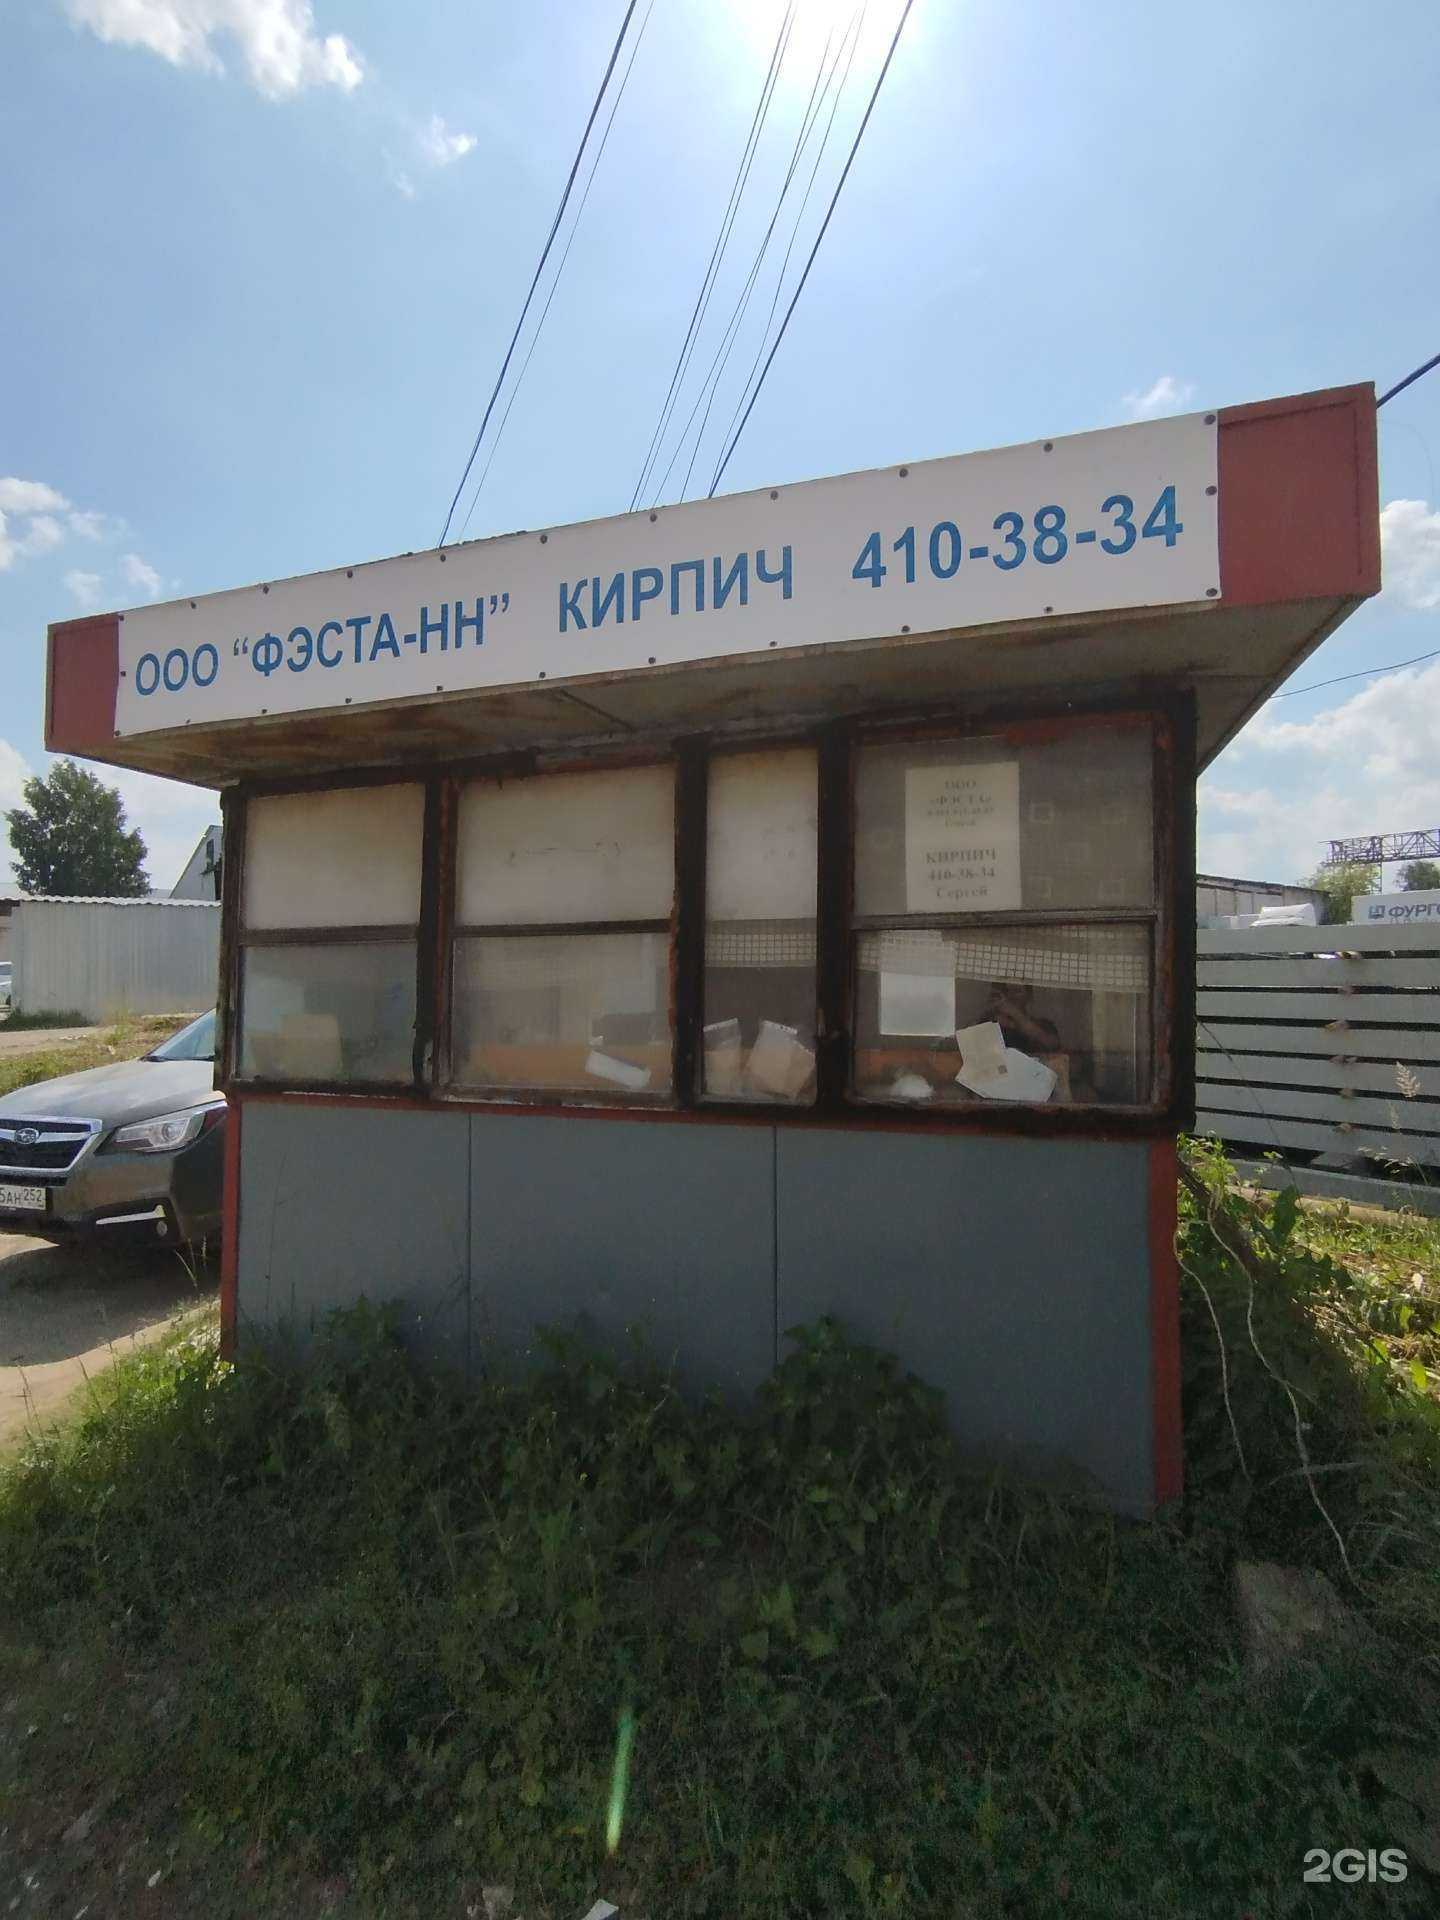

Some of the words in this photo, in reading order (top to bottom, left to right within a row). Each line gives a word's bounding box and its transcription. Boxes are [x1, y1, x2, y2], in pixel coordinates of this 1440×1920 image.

[135, 642, 219, 697] ООО
[557, 544, 793, 633] КИРПИЧ
[851, 484, 1184, 588] 410-38-34
[926, 848, 997, 864] КИРПИЧ
[1388, 903, 1440, 918] ФУРГ
